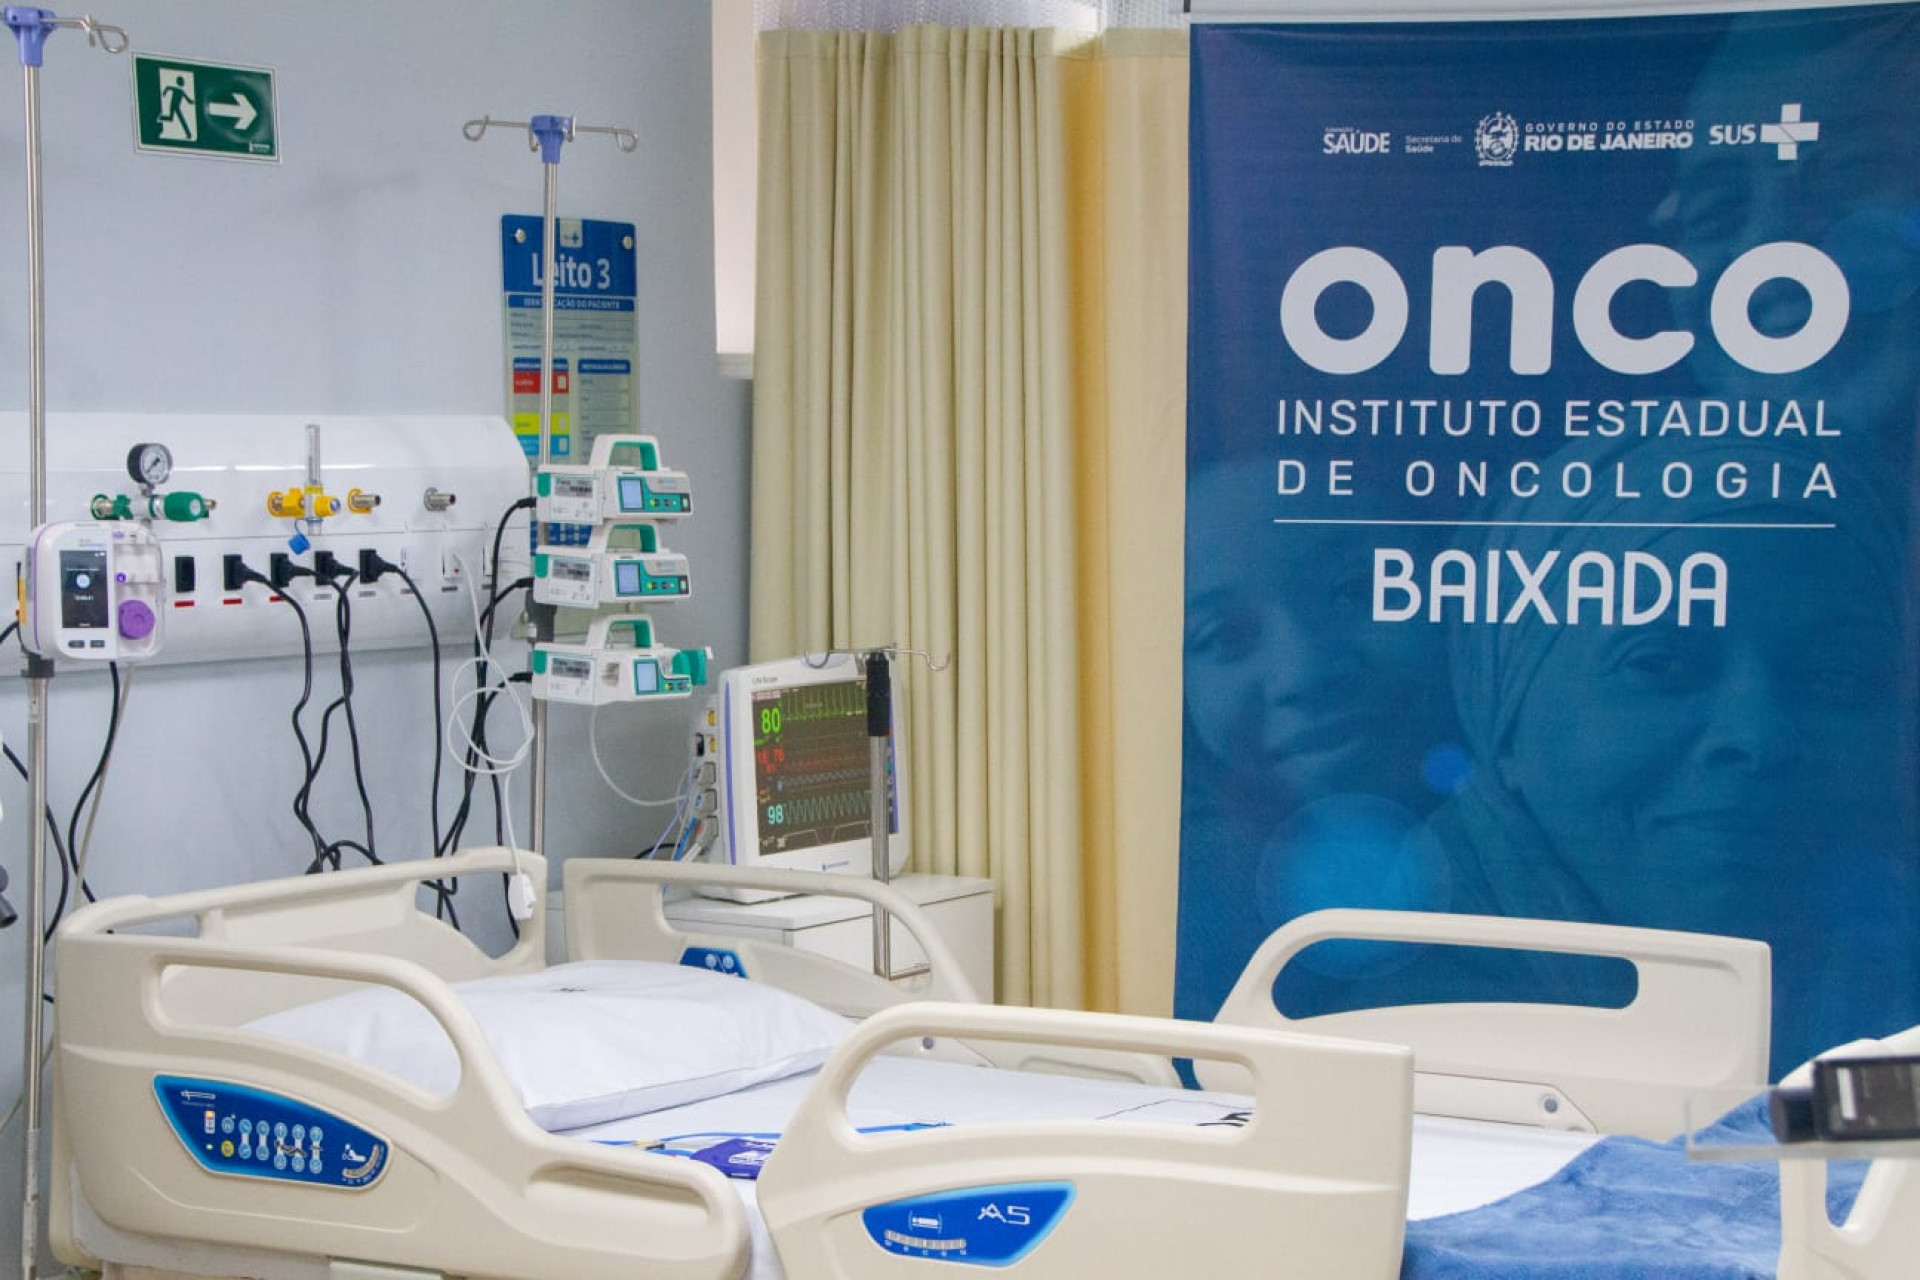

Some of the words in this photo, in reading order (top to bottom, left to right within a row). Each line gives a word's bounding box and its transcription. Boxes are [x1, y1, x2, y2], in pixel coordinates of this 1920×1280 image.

[1525, 121, 1598, 133] GOVERNO
[1606, 121, 1627, 132] DO
[1634, 119, 1695, 131] ESTADO
[1708, 123, 1757, 145] SUS
[1323, 128, 1391, 154] SAÚDE
[1524, 134, 1564, 152] RIO
[1566, 134, 1596, 152] DE
[1599, 131, 1694, 151] JANEIRO
[596, 257, 611, 290] 3
[1279, 241, 1850, 376] onco
[1278, 399, 1541, 437] INSTITUTO
[1564, 399, 1841, 437] ESTADUAL
[1277, 459, 1354, 496] DE
[1405, 460, 1837, 499] ONCOLOGIA
[1372, 547, 1728, 627] BAIXADA
[761, 708, 781, 734] 80
[767, 804, 783, 825] 98
[977, 1203, 1031, 1226] A5
